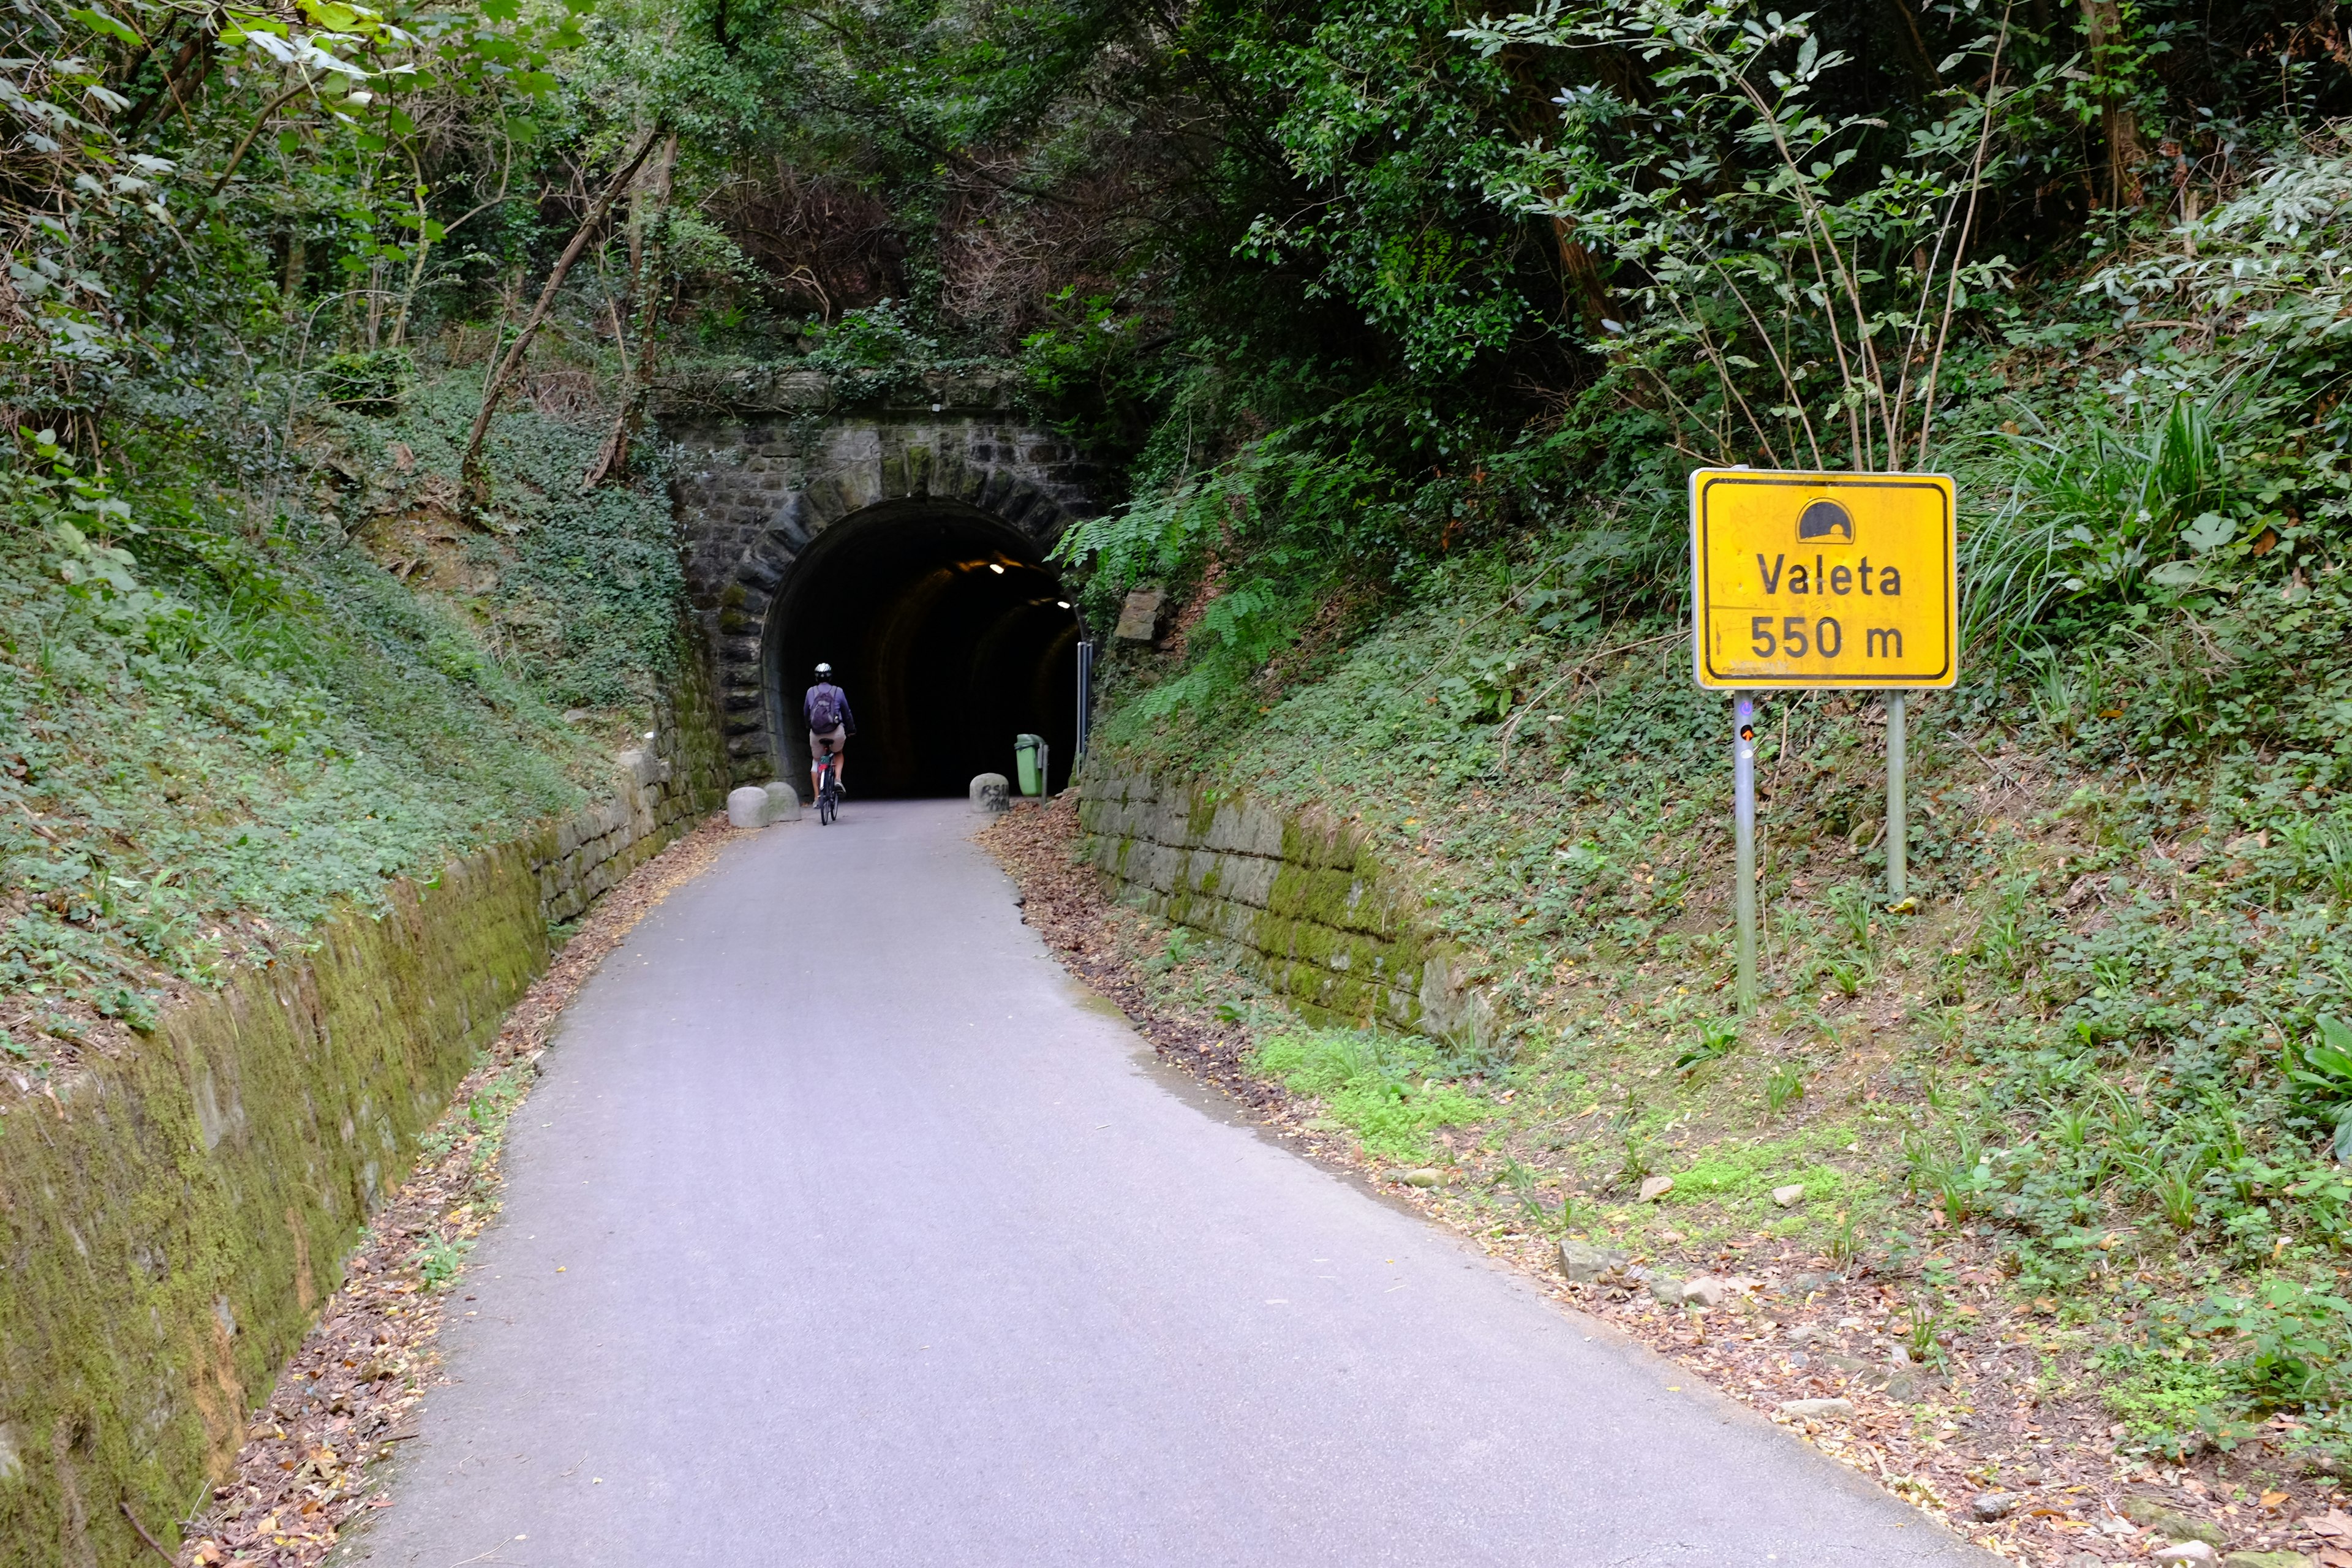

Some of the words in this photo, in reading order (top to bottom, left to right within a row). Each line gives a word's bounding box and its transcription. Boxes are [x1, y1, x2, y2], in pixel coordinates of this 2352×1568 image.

[1757, 554, 1901, 596] Valeta
[1751, 616, 1842, 658] 550
[1866, 628, 1902, 658] m
